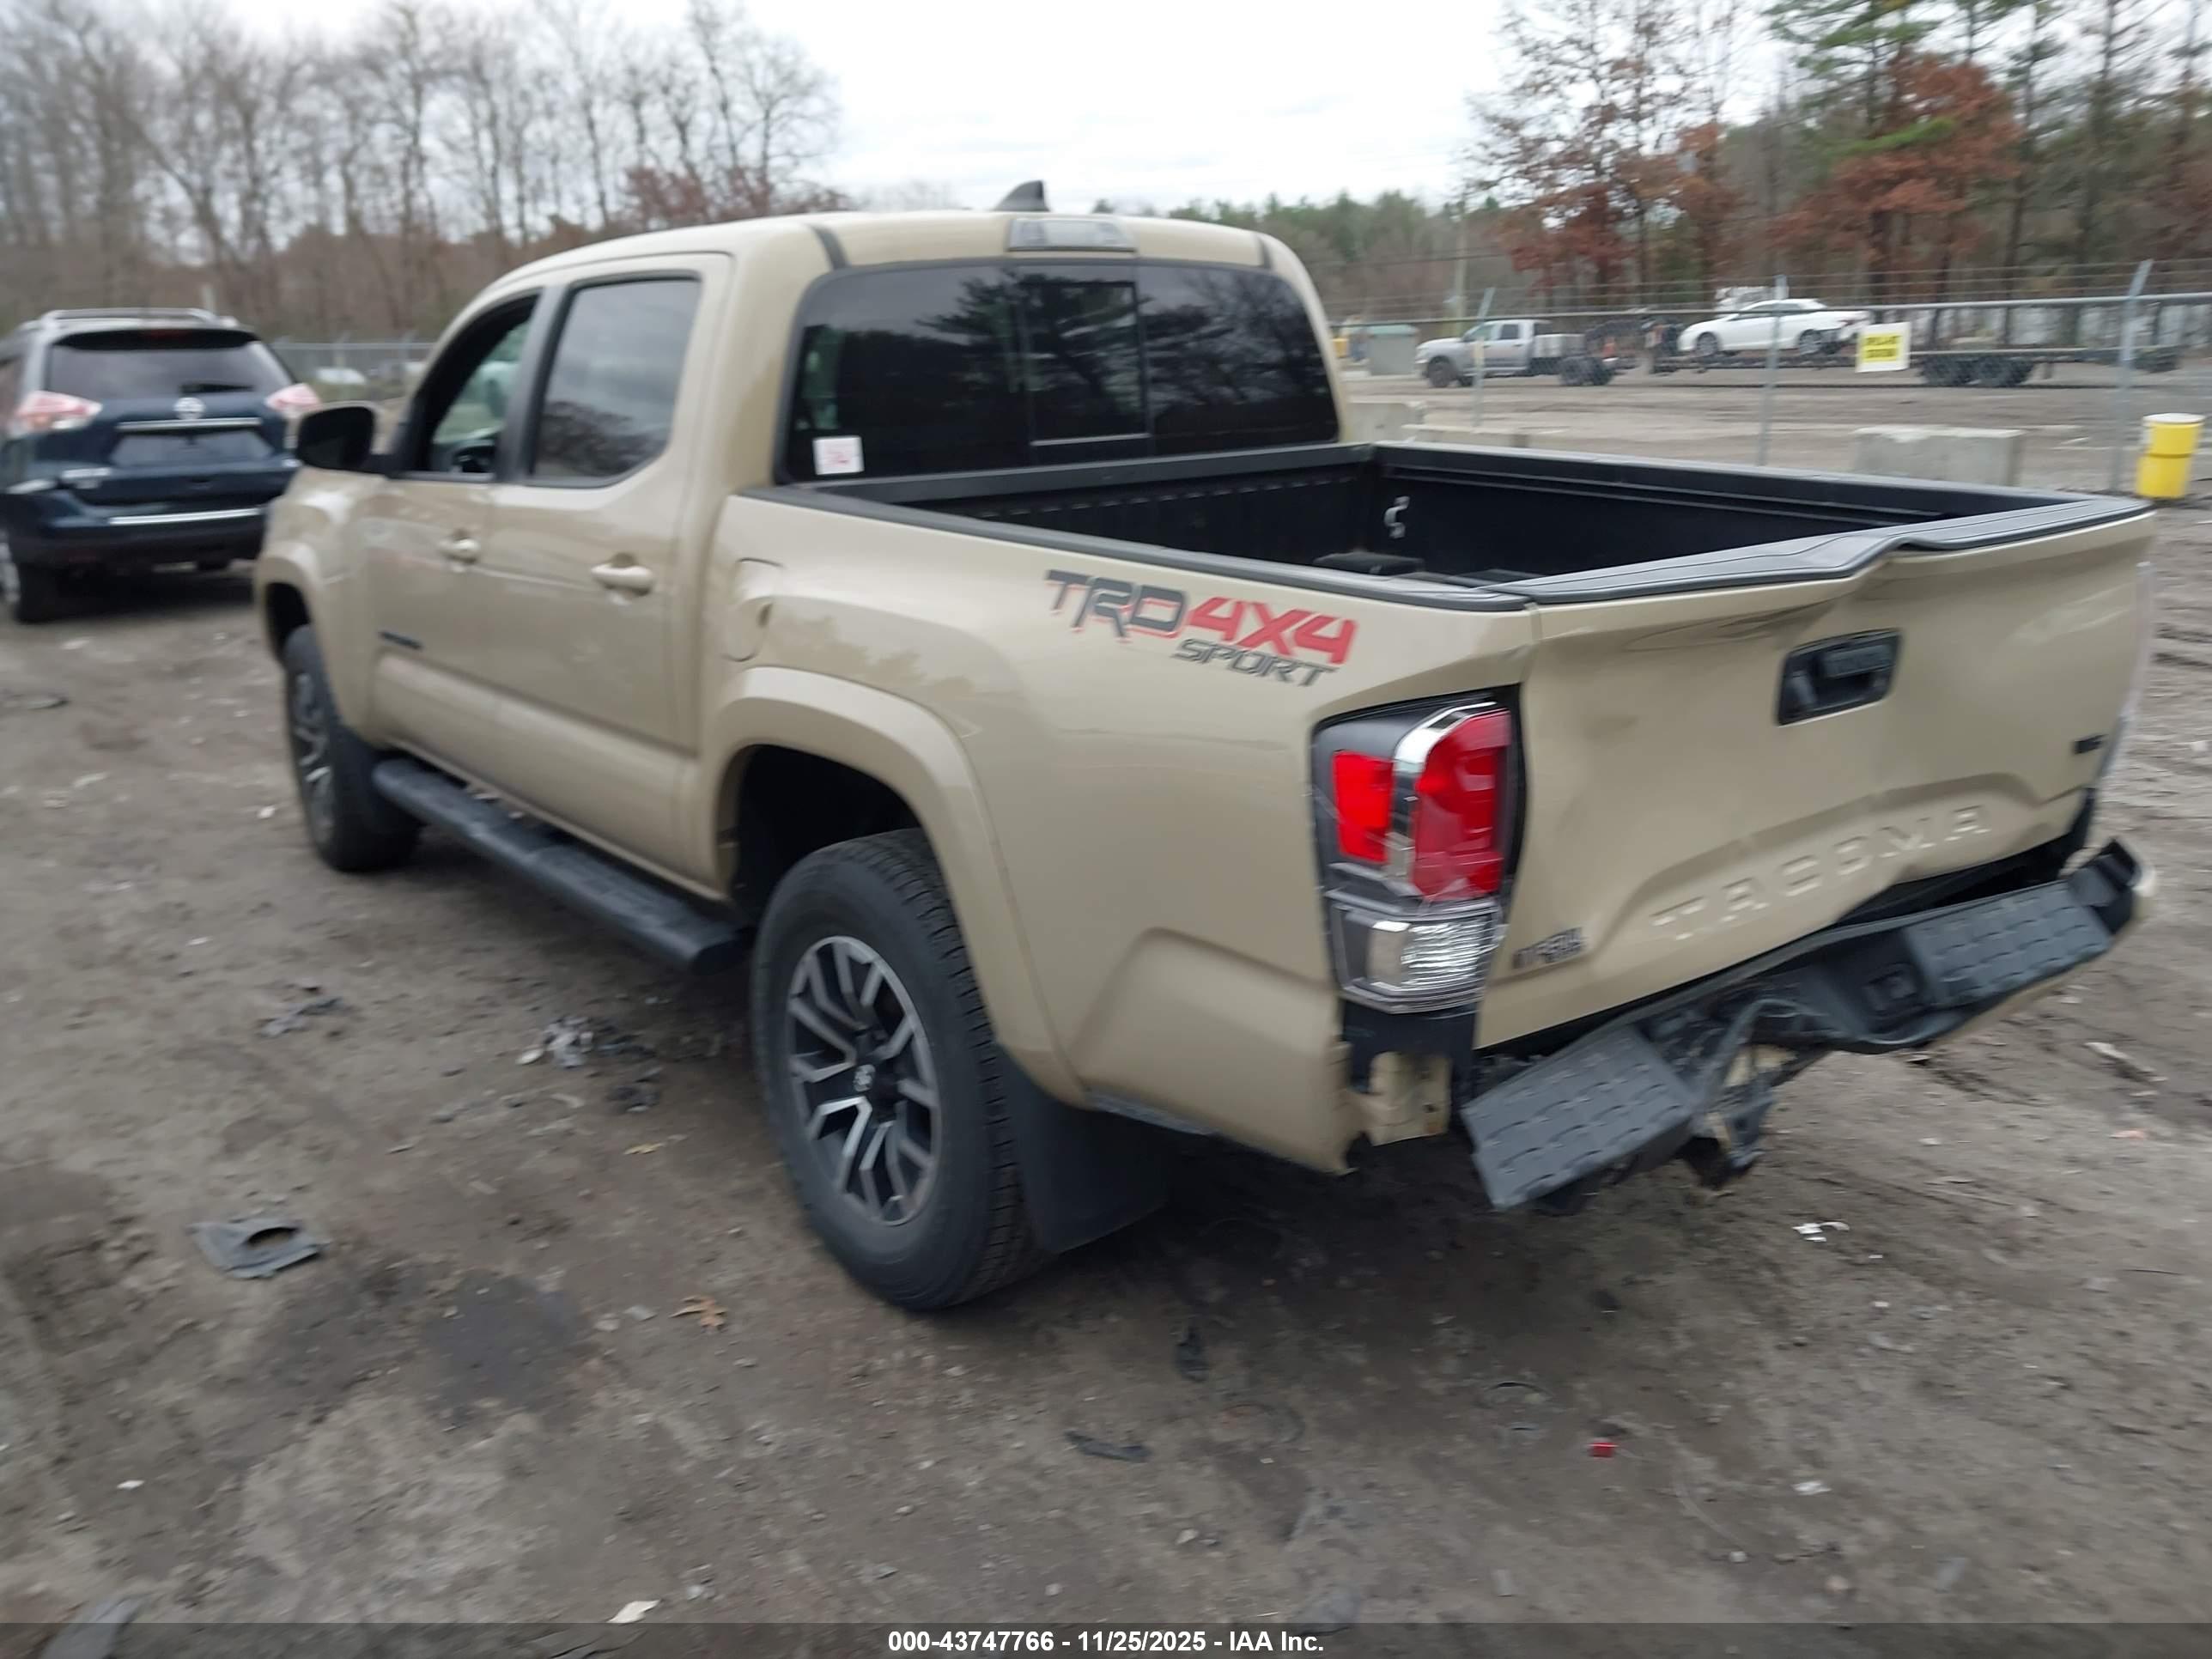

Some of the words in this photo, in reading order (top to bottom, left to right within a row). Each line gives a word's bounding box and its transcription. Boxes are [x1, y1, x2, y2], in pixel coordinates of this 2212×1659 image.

[1044, 568, 1190, 644] TRD
[1171, 638, 1341, 688] SPORT
[1648, 804, 1992, 941] TACOMA
